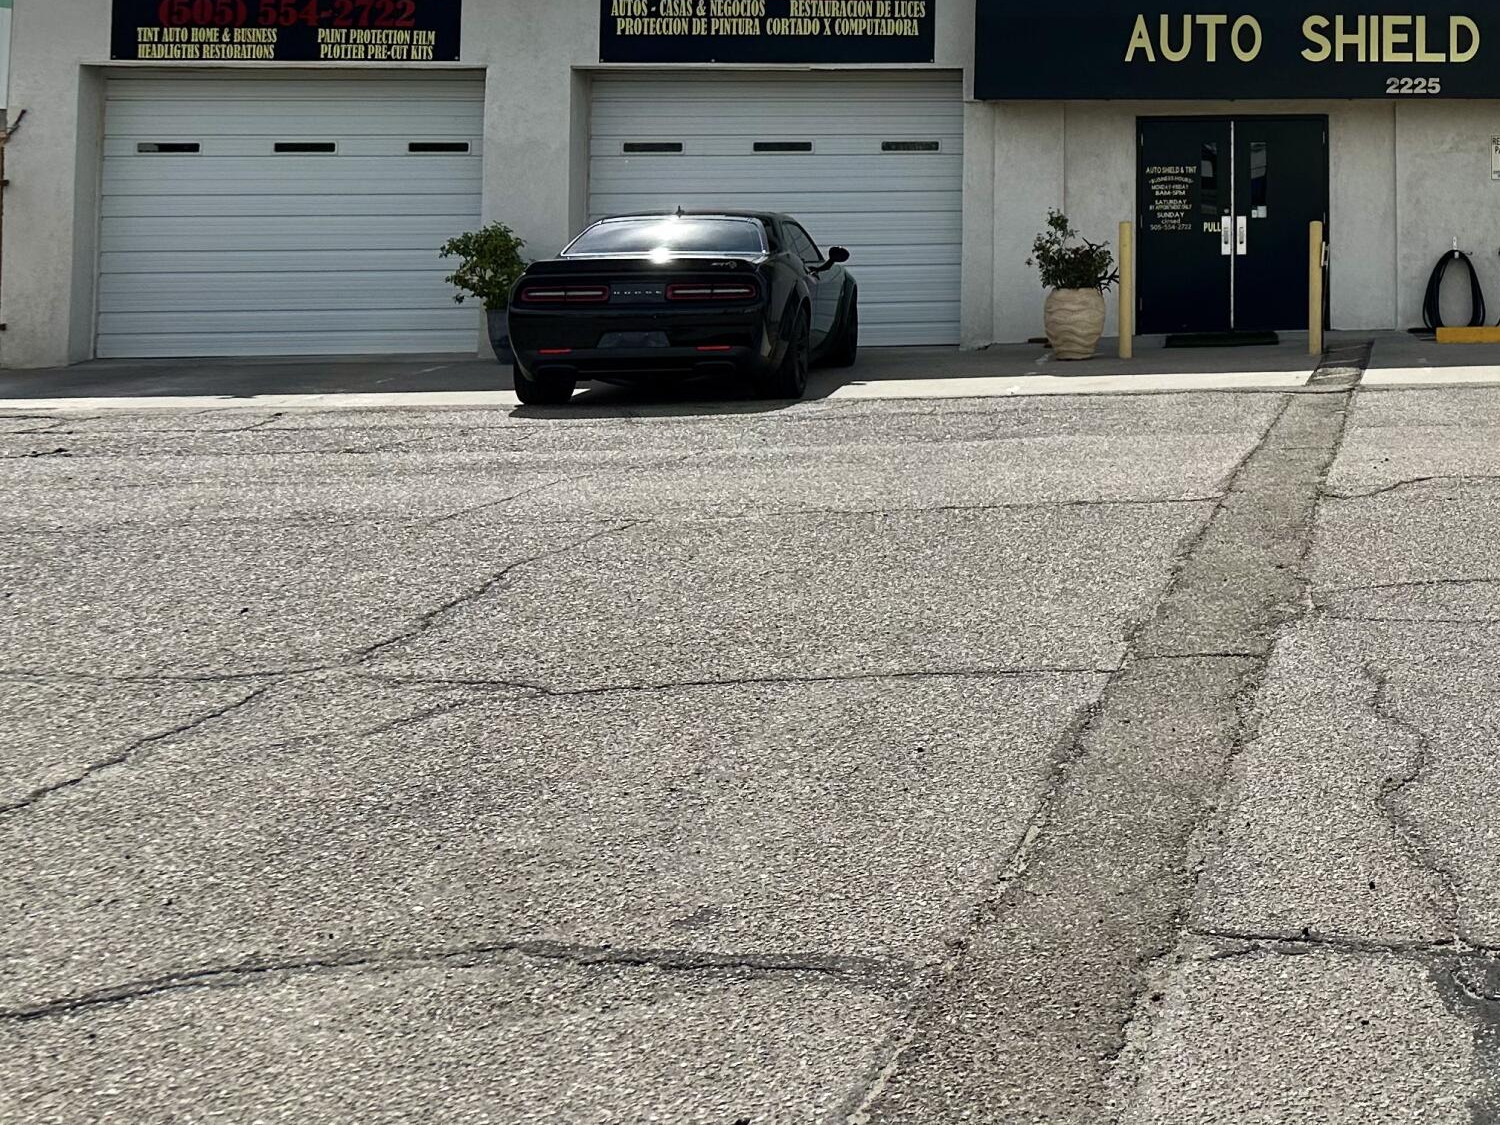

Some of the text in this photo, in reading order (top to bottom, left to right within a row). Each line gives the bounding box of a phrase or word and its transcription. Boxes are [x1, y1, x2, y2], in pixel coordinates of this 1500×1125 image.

[610, 0, 648, 17] AUTOS
[659, 0, 693, 17] CASAS
[696, 0, 707, 17] &
[710, 0, 766, 17] NEGOCIOS
[790, 0, 926, 18] RESTAURACION DE LUCES
[136, 27, 278, 43] TINT AUTO HOME & BUSINESS
[616, 18, 761, 35] PROTECCION DE PINTURA
[766, 18, 919, 36] CORTADO X COMPUTADORA
[317, 28, 436, 45] PAINT PROTECTION FILM
[1124, 14, 1263, 63] AUTO
[1300, 14, 1480, 63] SHIELD
[137, 44, 275, 59] HEADLIGTHS RESTORATIONS
[320, 44, 434, 60] PLOTTER PRE-CUT KITS
[1385, 77, 1441, 94] 2225
[1145, 166, 1197, 174] AUTO SHIELD & TINT
[1203, 222, 1221, 233] PULL
